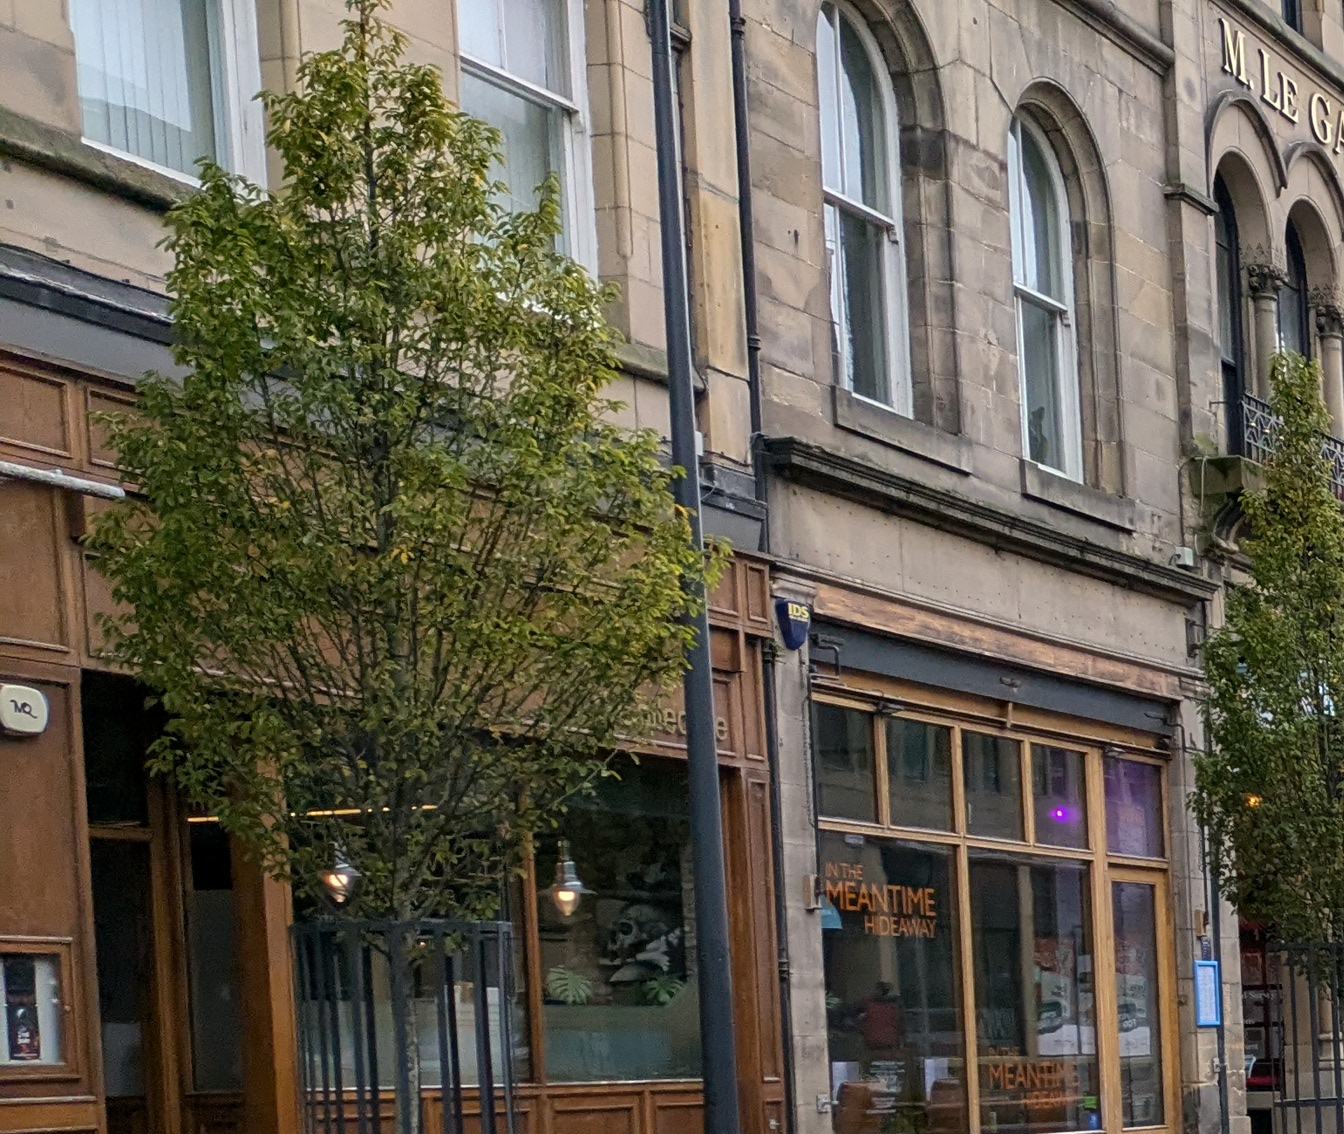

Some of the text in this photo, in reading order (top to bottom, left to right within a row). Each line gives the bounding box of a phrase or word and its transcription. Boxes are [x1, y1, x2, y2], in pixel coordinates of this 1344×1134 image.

[1219, 18, 1254, 90] M.
[1258, 48, 1299, 124] LE
[788, 603, 809, 618] IDS
[825, 862, 863, 880] IN THE
[826, 881, 937, 916] MEANTIME
[865, 916, 937, 939] HIDEAWAY
